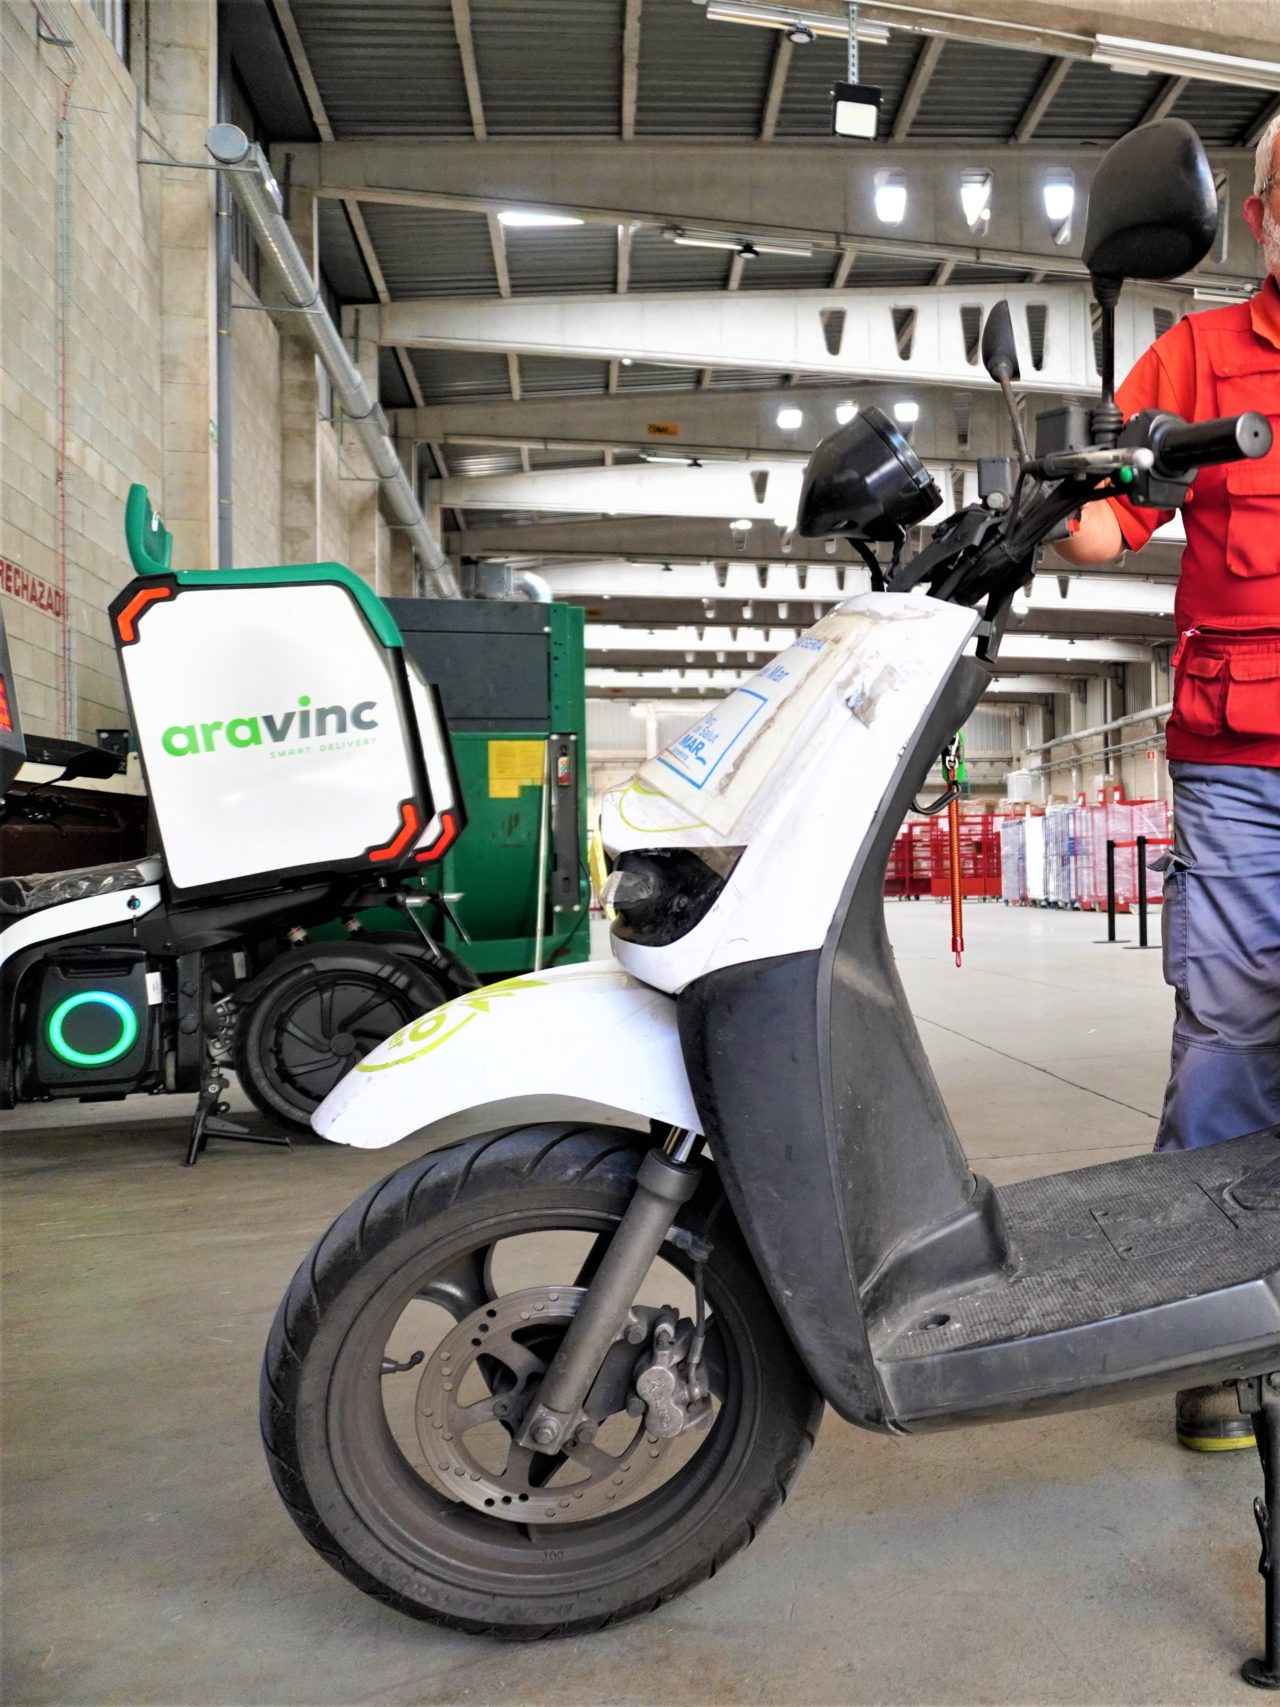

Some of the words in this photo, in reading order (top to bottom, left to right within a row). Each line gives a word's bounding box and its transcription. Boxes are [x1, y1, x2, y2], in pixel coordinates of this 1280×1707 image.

[162, 695, 379, 757] aravinc
[269, 746, 311, 760] SMART
[319, 737, 377, 752] DELIVERY
